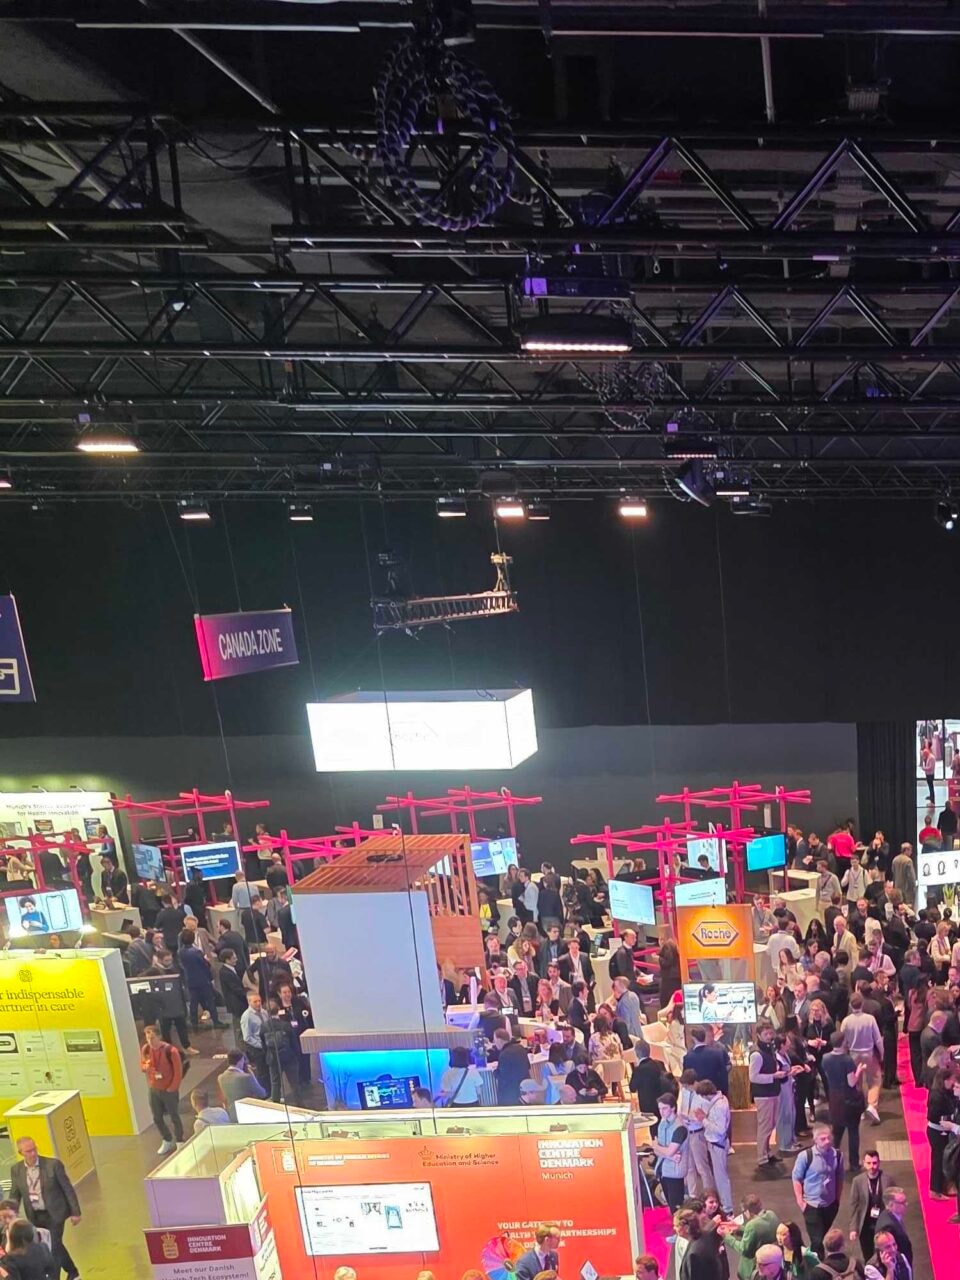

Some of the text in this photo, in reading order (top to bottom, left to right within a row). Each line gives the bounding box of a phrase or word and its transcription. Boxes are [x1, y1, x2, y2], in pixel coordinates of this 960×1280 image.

[218, 628, 283, 660] CANADA ZONE
[701, 927, 732, 939] Roche
[5, 988, 85, 1004] indispensable
[0, 1002, 76, 1012] artner in care
[538, 1138, 604, 1149] INNOVATION
[474, 1152, 496, 1160] Higher
[538, 1149, 581, 1158] CENTRE
[540, 1158, 594, 1168] DENMARK
[541, 1172, 574, 1180] Munich
[497, 1222, 521, 1230] YOUR
[562, 1219, 574, 1227] TO
[187, 1234, 227, 1242] INNOVATION
[560, 1228, 617, 1238] ARTNERSHIPS
[209, 1264, 235, 1272] Danish
